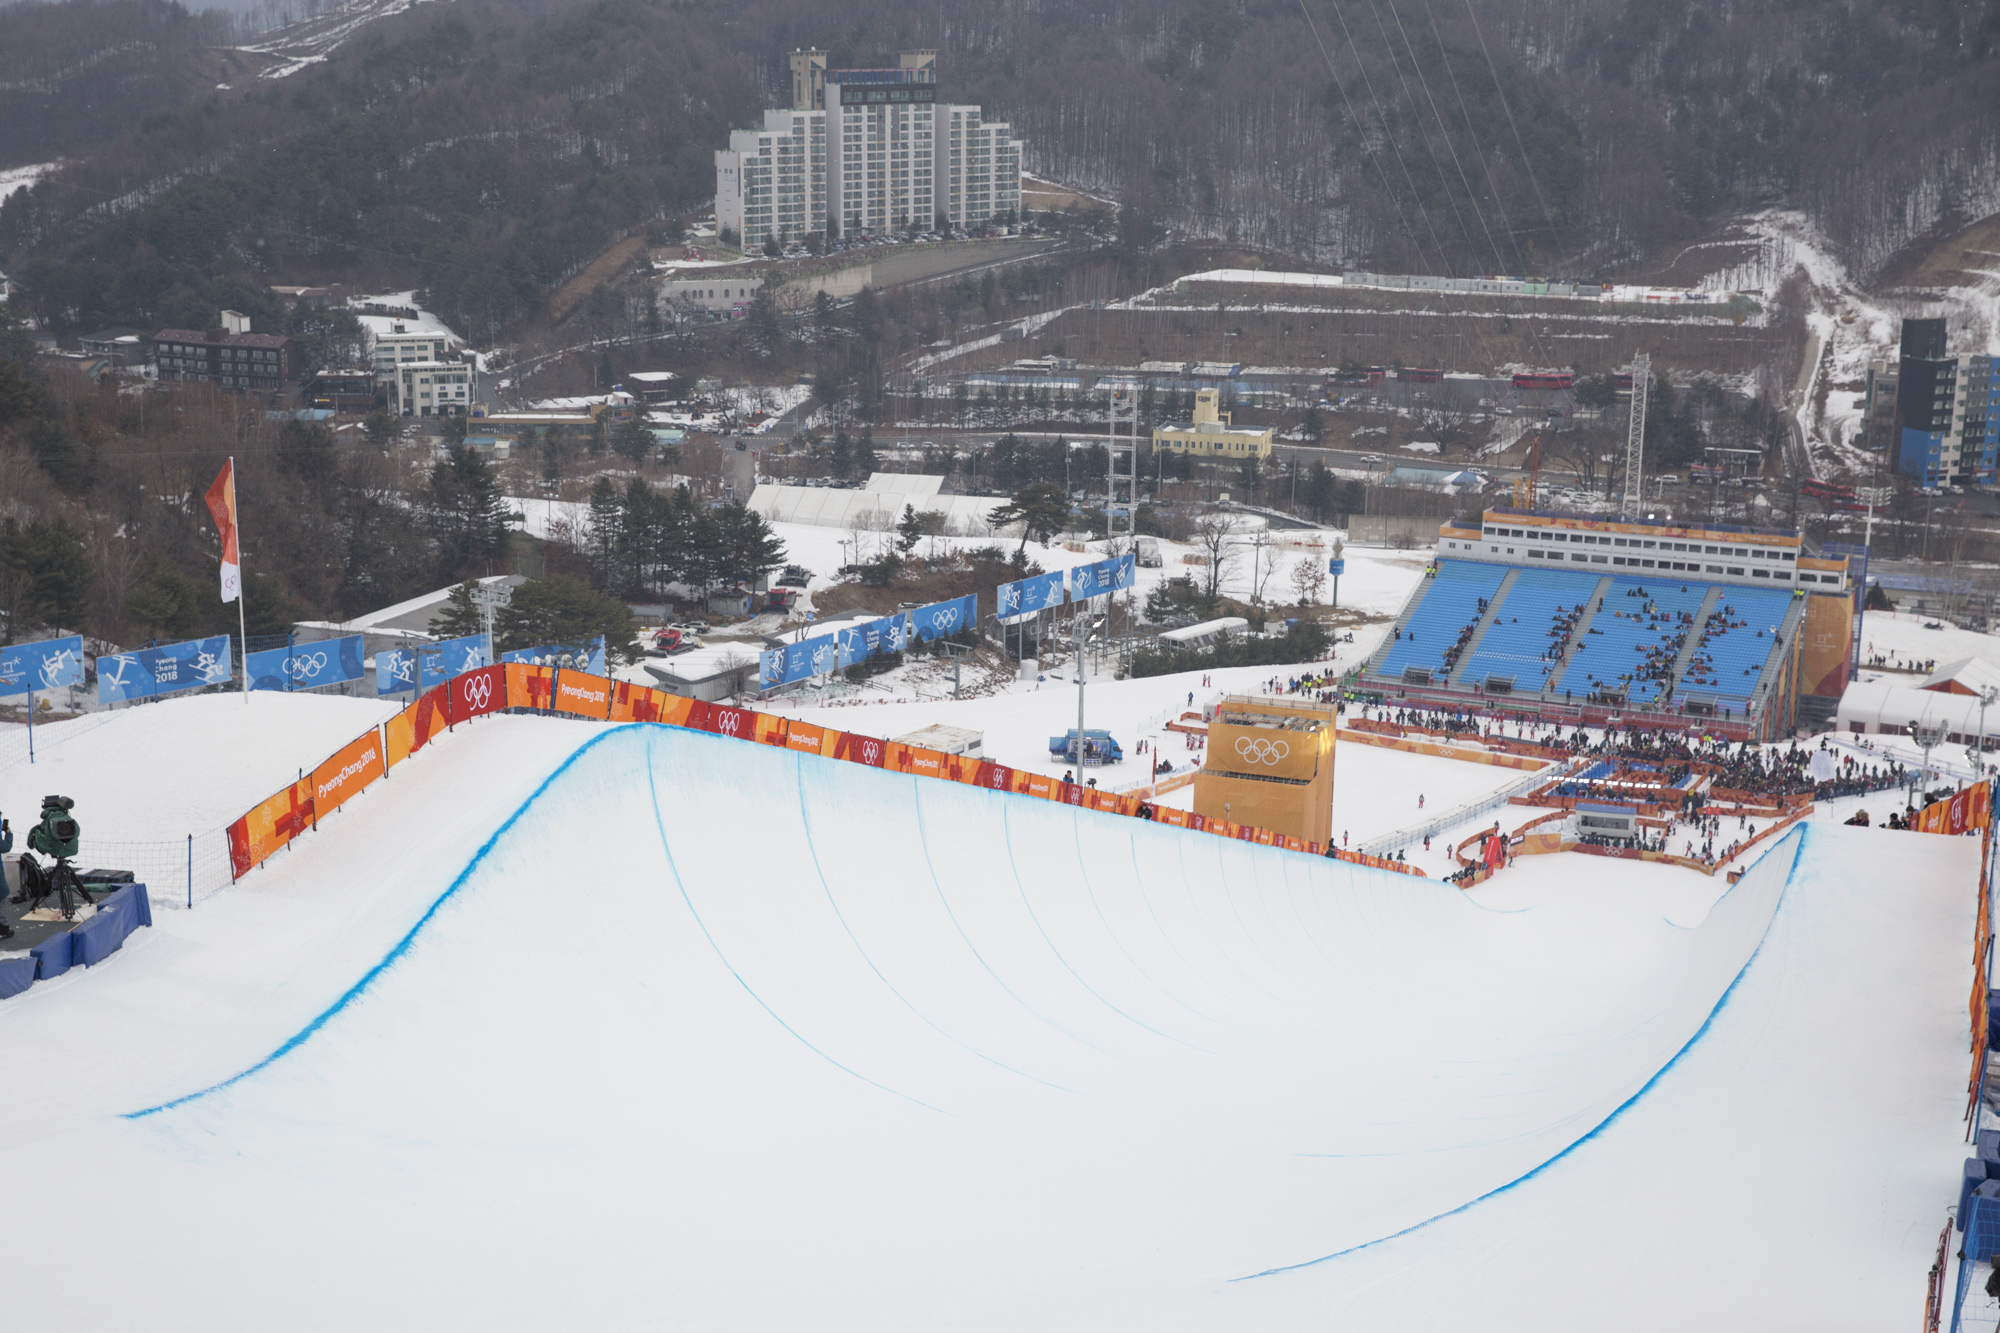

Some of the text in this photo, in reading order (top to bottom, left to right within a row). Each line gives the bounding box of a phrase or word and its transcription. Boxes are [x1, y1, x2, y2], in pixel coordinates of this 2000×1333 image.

[155, 670, 178, 684] 2018
[318, 746, 377, 798] PyeongChang 2018
